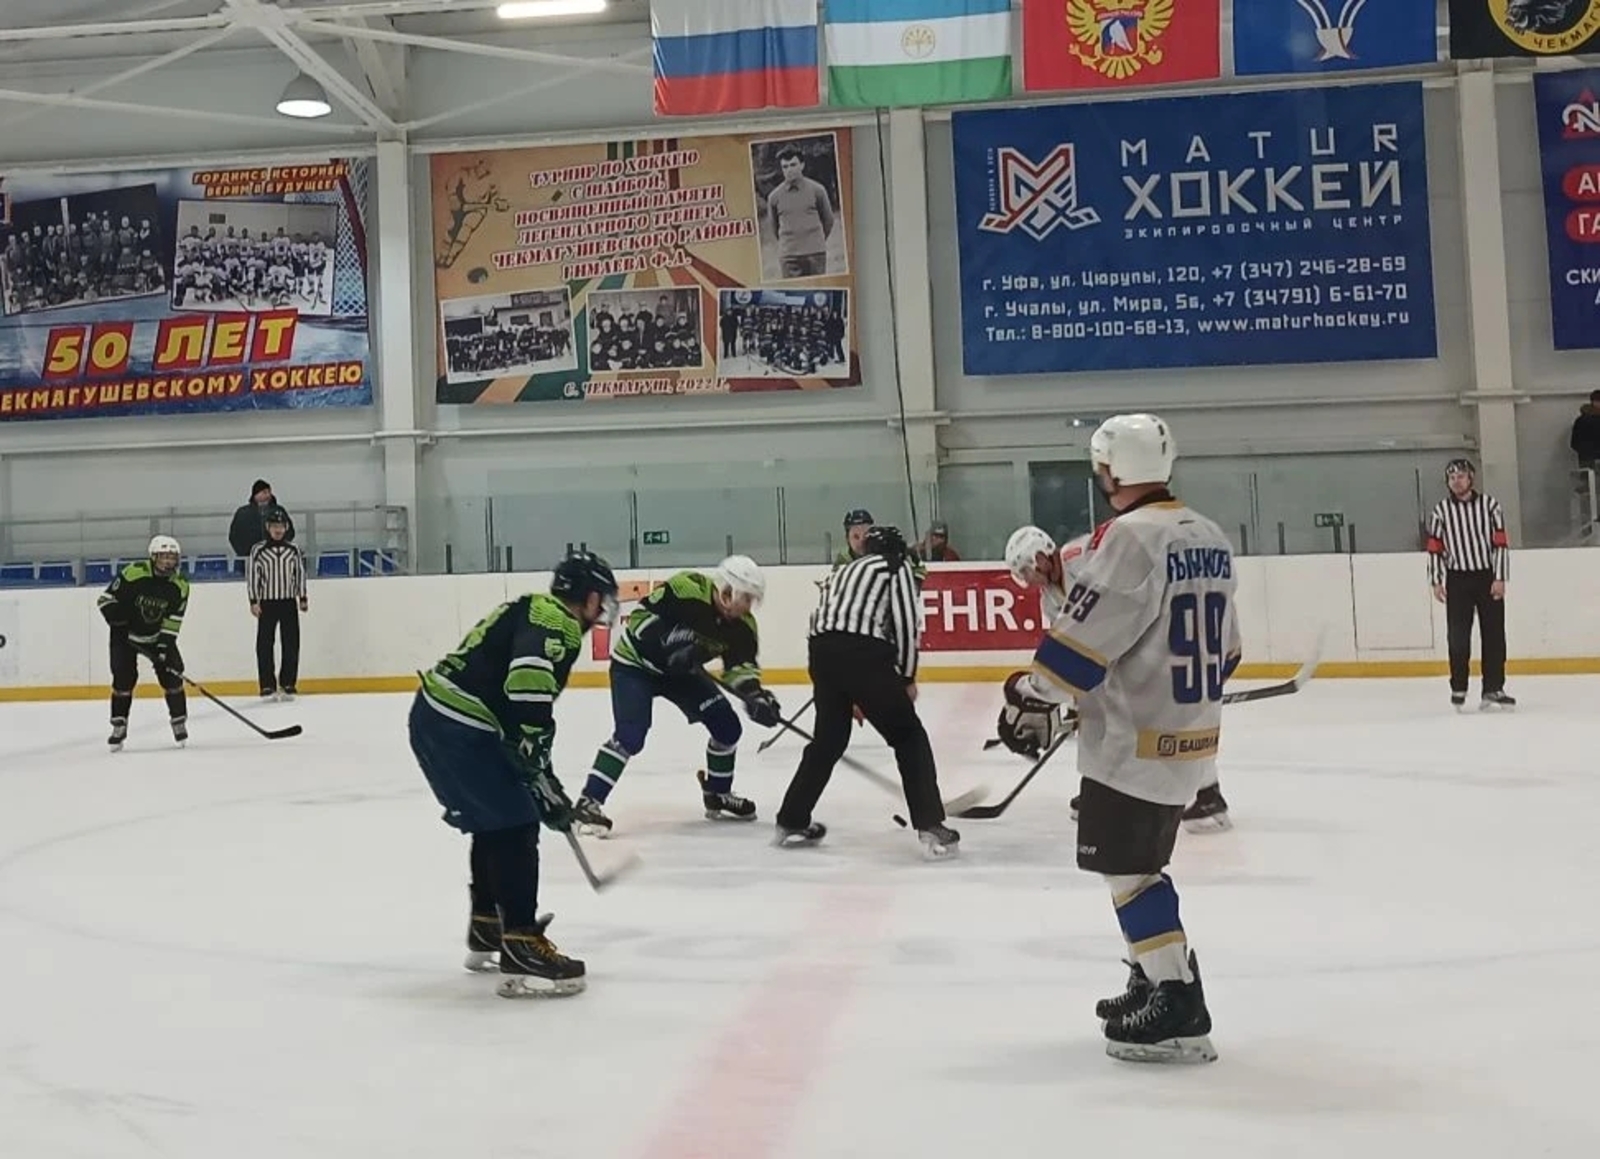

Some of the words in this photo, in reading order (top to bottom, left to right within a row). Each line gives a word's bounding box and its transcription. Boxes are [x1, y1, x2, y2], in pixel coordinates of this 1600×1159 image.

[529, 164, 598, 188] ТУРНИР
[626, 148, 699, 174] ХОККЕЮ
[651, 184, 724, 208] ПАМЯТИ
[1122, 160, 1402, 220] ХОККЕЙ
[653, 202, 727, 227] ТРЕНЕРА
[1124, 217, 1313, 240] ЭКИПИРОВОЧНЫЙ
[1332, 214, 1403, 231] ЦЕНТР
[492, 230, 676, 270] ЧЕКМАГУШЕВСКОГО
[678, 218, 755, 245] РАЙОНА
[1001, 274, 1045, 292] Уфа,
[1050, 275, 1076, 290] ул.
[1081, 271, 1163, 287] Цюрупы,
[1167, 266, 1206, 283] 120,
[1211, 264, 1233, 280] +7
[1240, 259, 1293, 281] (347)
[1299, 256, 1406, 276] 246-28-69
[1005, 301, 1073, 317] Учалы,
[1078, 300, 1106, 315] ул.
[1113, 295, 1169, 312] Мира,
[1212, 290, 1236, 307] +7
[1243, 285, 1321, 308] (34791)
[1329, 283, 1408, 303] 6-61-70
[1031, 318, 1191, 339] 8-800-100-68-13,
[1197, 311, 1410, 332] www.maturhockey.ru
[47, 330, 130, 373] 50
[157, 317, 297, 366] ЛЕТ
[252, 364, 363, 391] ХОККЕЮ
[920, 588, 1050, 632] FHR.
[1168, 591, 1227, 704] 99
